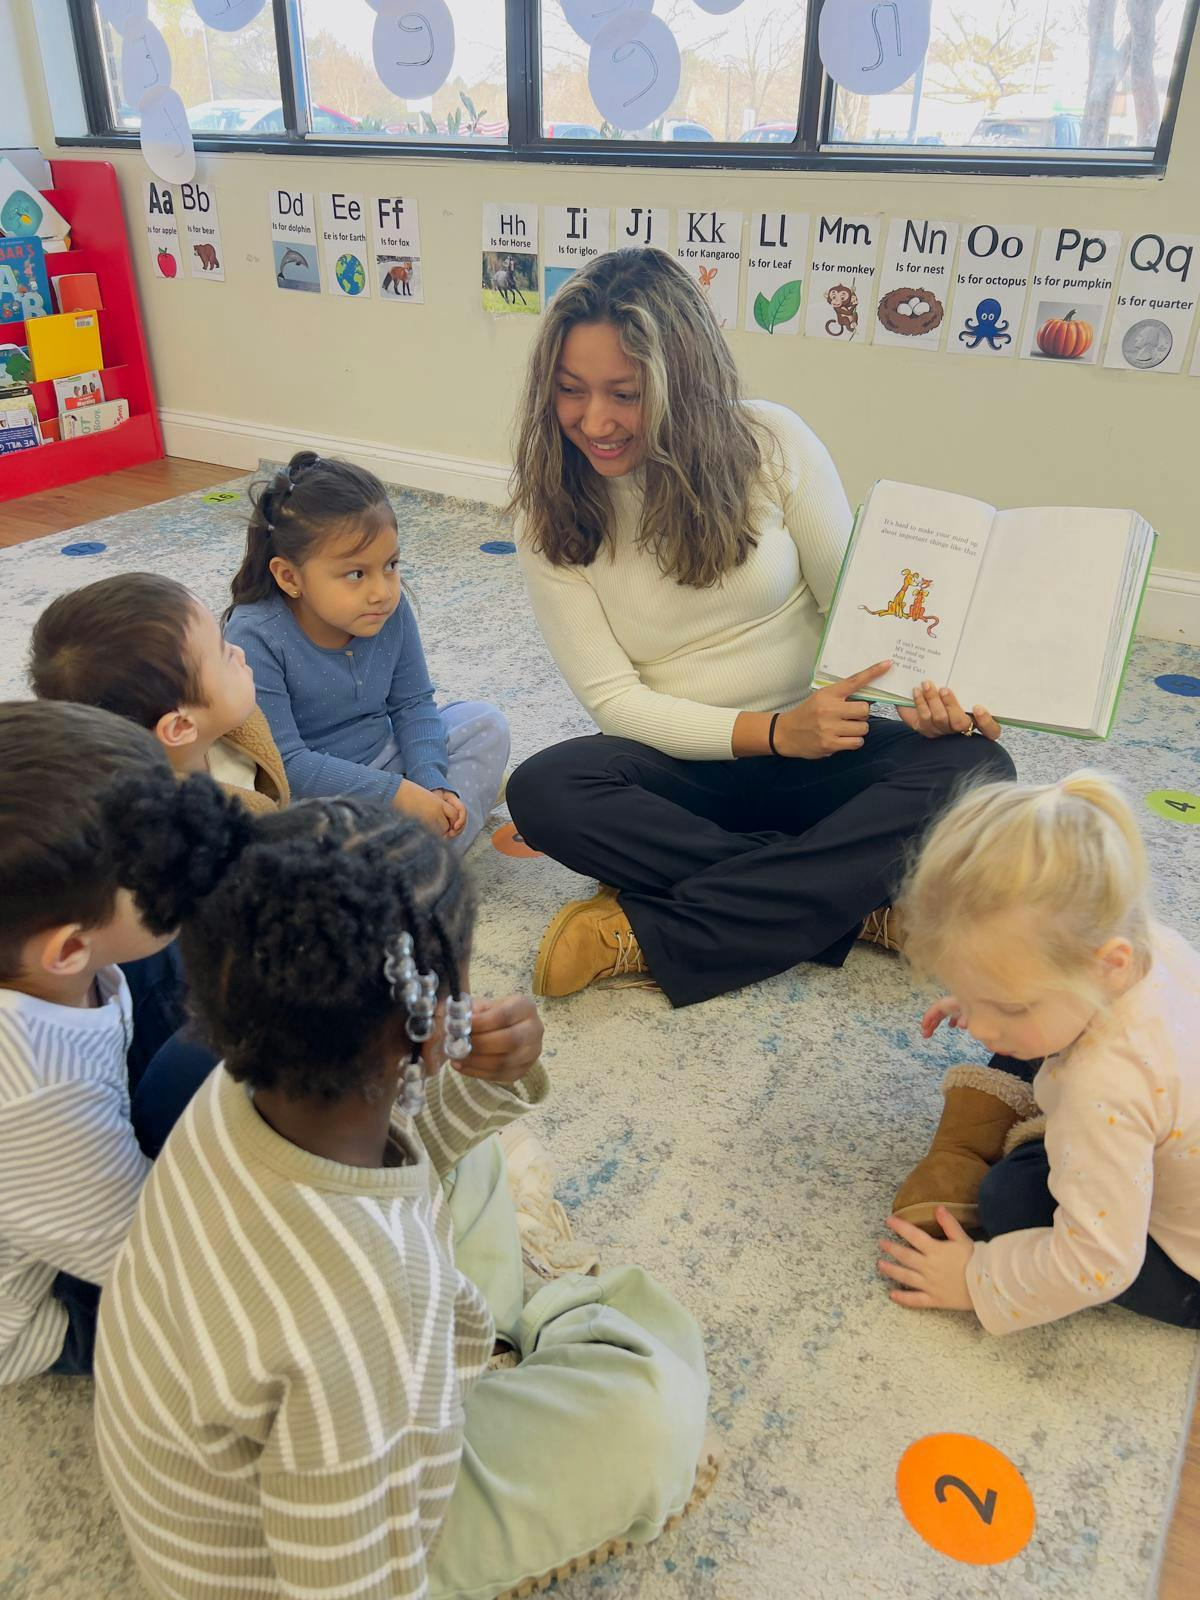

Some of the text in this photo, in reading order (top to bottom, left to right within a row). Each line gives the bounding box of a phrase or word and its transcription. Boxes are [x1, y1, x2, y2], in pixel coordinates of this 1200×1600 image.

[149, 183, 174, 214] Aa
[181, 184, 210, 212] Bb
[278, 191, 303, 216] Dd
[332, 193, 361, 220] Ee
[378, 199, 403, 229] Ff
[566, 208, 587, 239] Ii
[162, 228, 177, 236] apple
[202, 227, 215, 235] bear
[279, 223, 287, 231] for
[288, 224, 311, 234] dolphin
[501, 215, 526, 236] Hh
[626, 209, 652, 244] Jj
[687, 212, 726, 243] Kk
[760, 214, 787, 247] Ll
[819, 217, 871, 245] Mm
[350, 234, 366, 242] Earth
[399, 238, 410, 246] fox
[499, 238, 509, 246] for
[511, 239, 531, 248] Horse
[903, 220, 947, 254] Nn
[967, 225, 1023, 258] Oo
[559, 245, 597, 256] Is for igloo
[678, 248, 740, 260] Is for Kangaroo
[1056, 229, 1106, 271] Pp
[1130, 234, 1193, 282] Qq
[749, 259, 792, 269] Is for Leaf
[813, 262, 875, 276] Is for monkey
[896, 263, 944, 274] Is for nest
[957, 274, 1027, 288] Is for octopus
[1033, 276, 1112, 290] Is for pumpkin
[1118, 296, 1193, 310] Is for quarter
[1164, 800, 1196, 812] 4
[934, 1474, 997, 1525] 2
